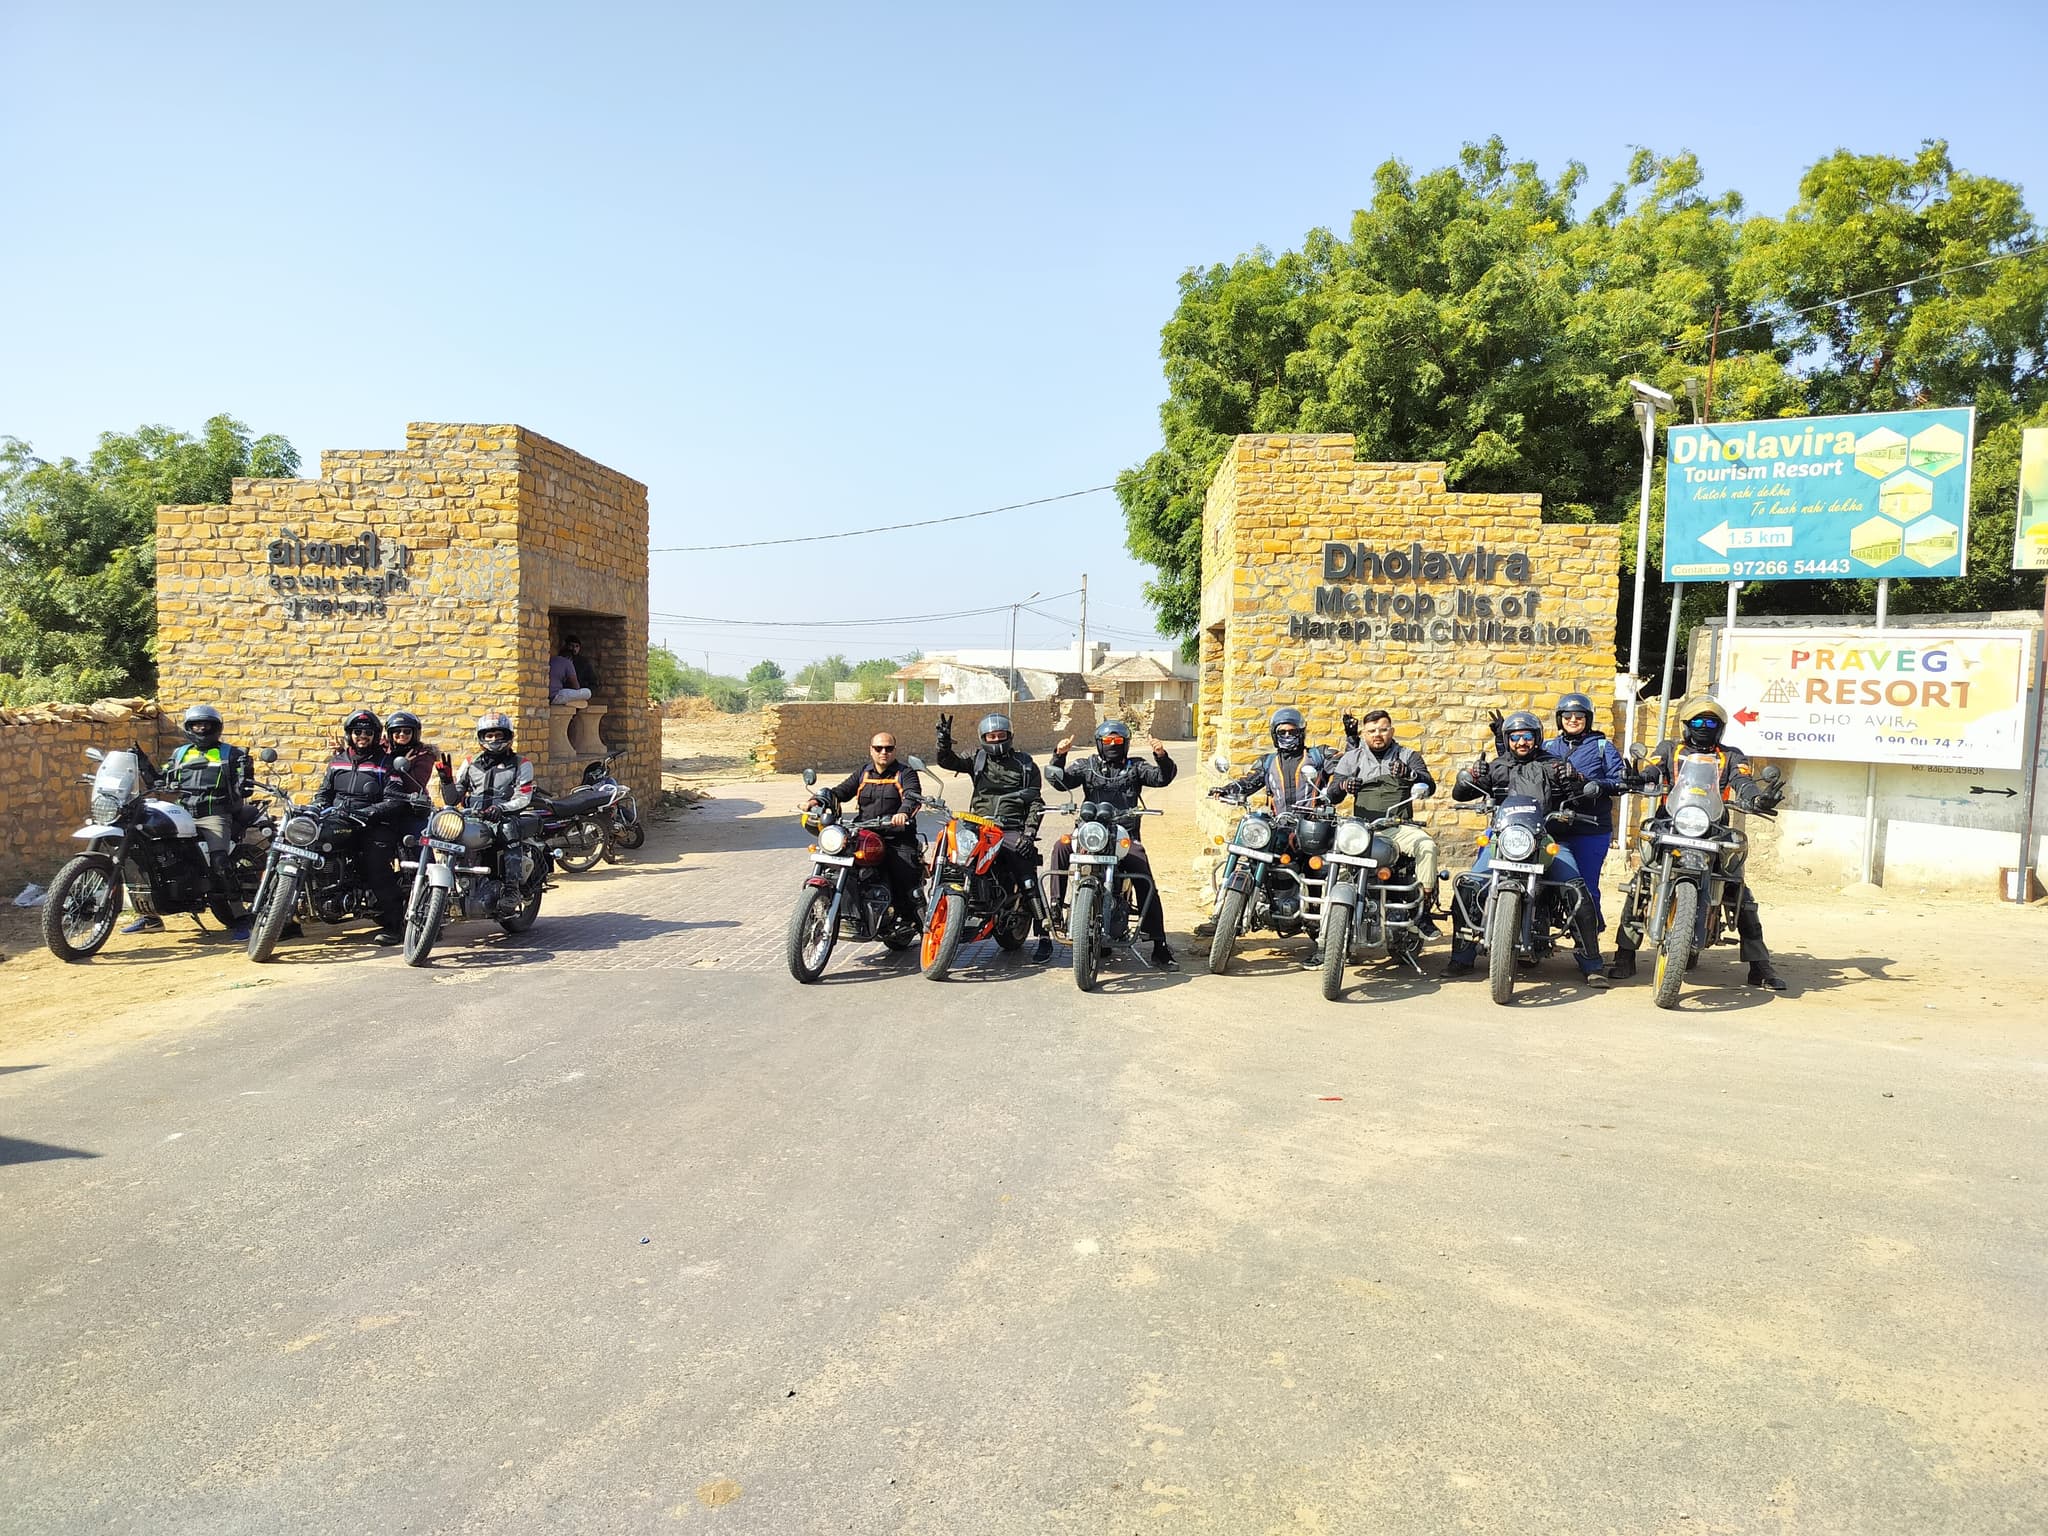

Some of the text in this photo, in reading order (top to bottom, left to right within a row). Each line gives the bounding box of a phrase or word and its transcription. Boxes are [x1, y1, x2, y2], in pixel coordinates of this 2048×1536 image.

[1674, 426, 1855, 464] Dholavira
[1684, 459, 1844, 483] Tourism Resort
[1731, 486, 1755, 499] nahi
[1757, 484, 1791, 498] dekha
[1801, 501, 1825, 513] nahi
[1828, 498, 1864, 513] dekha
[1728, 531, 1786, 545] 1.5 km
[1322, 542, 1530, 581] Dholavira
[1674, 566, 1712, 575] Contact
[1732, 561, 1788, 576] 97266
[1793, 559, 1850, 574] 54443
[1314, 586, 1541, 620] Metropolis of
[1288, 615, 1592, 647] Harappan Civilization
[1791, 649, 1948, 672] PRAVEG
[1805, 678, 1971, 709] RESORT
[1809, 712, 1919, 728] DHOAVIRA
